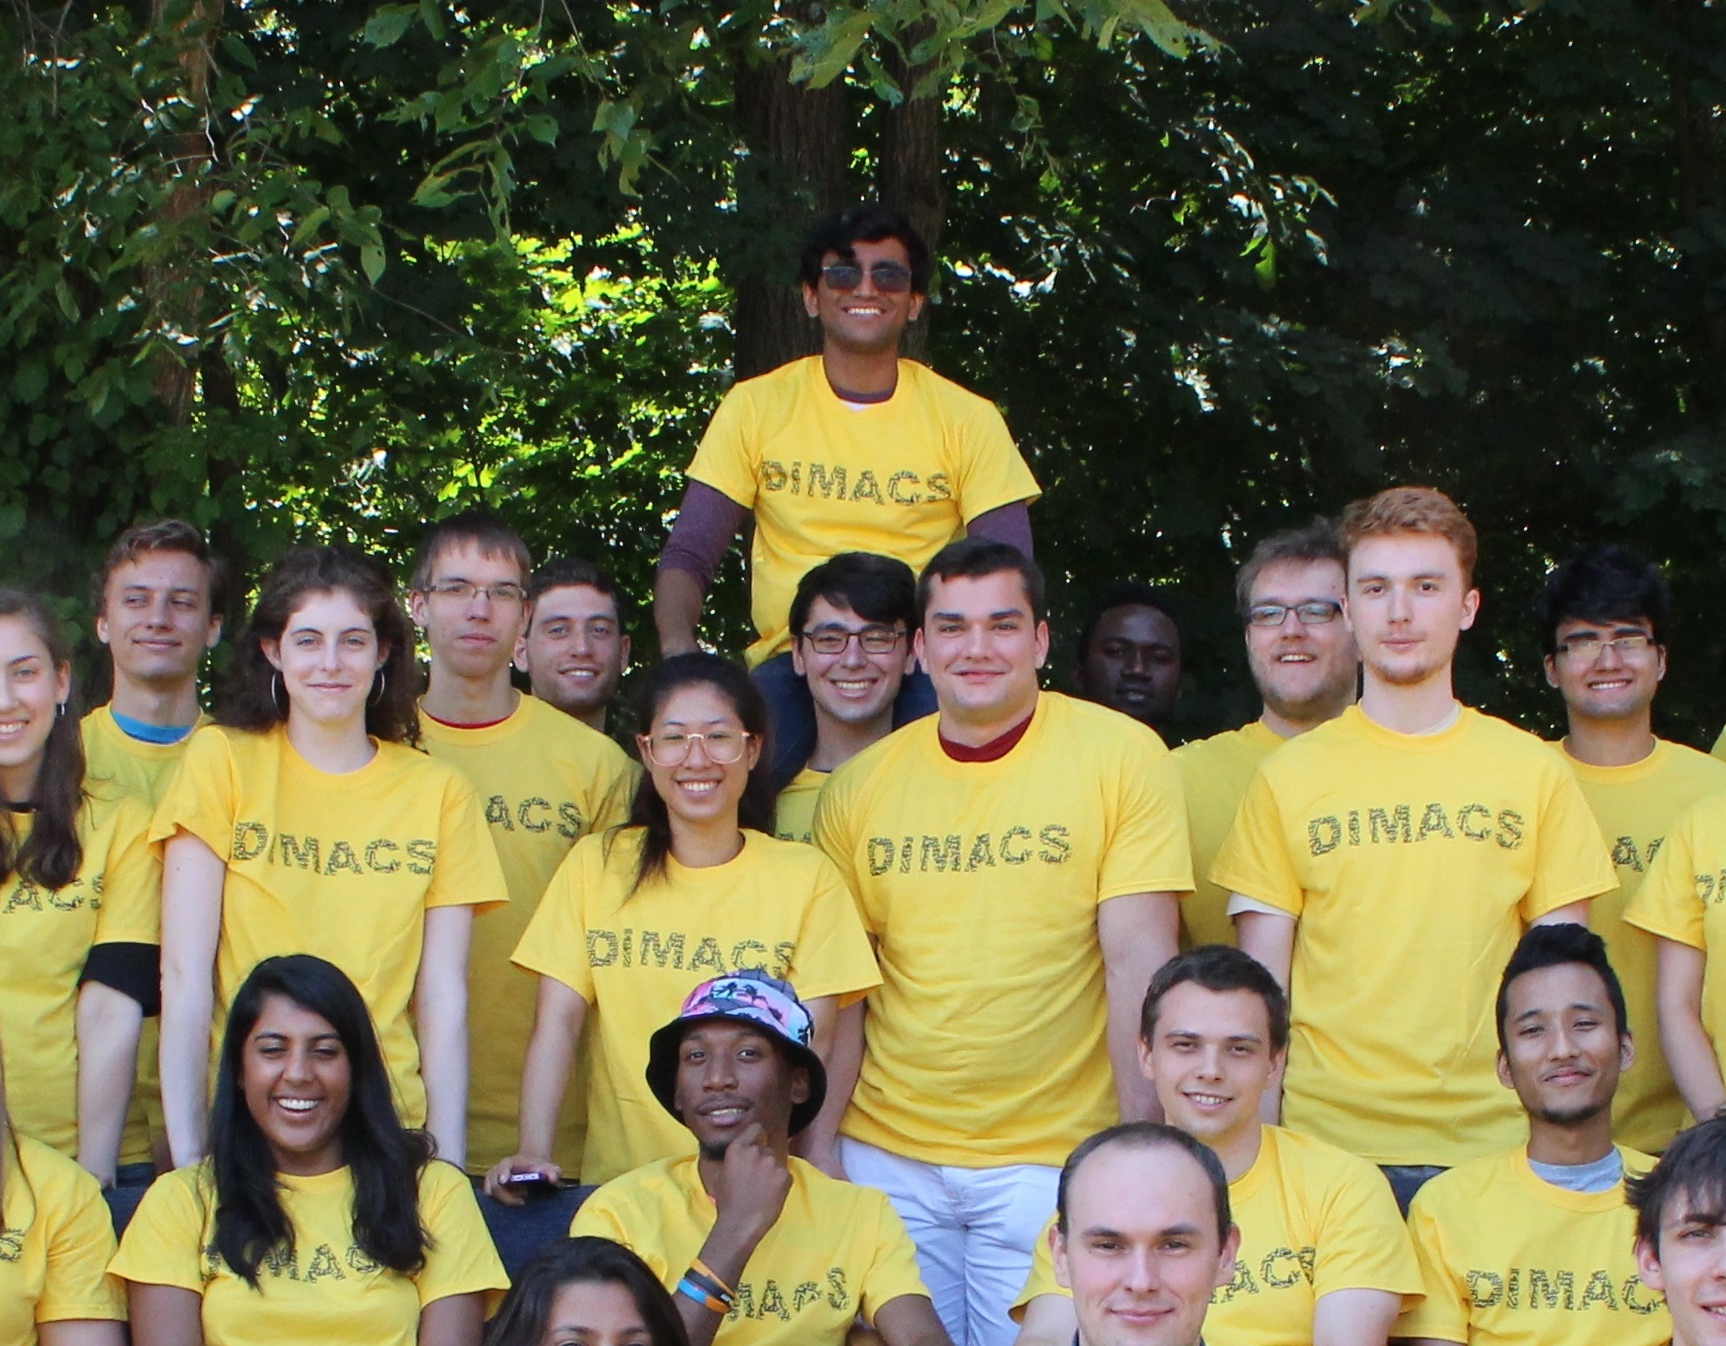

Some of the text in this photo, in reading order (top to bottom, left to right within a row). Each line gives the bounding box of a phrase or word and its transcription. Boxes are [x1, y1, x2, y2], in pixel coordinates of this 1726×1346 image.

[759, 459, 951, 506] DIMACS
[485, 795, 582, 839] ACS
[1308, 802, 1524, 857] DIMACS
[233, 822, 437, 876] DMACS
[868, 823, 1071, 877] DIMACS
[586, 928, 797, 980] DIMACS
[1466, 1268, 1660, 1315] DIMAC
